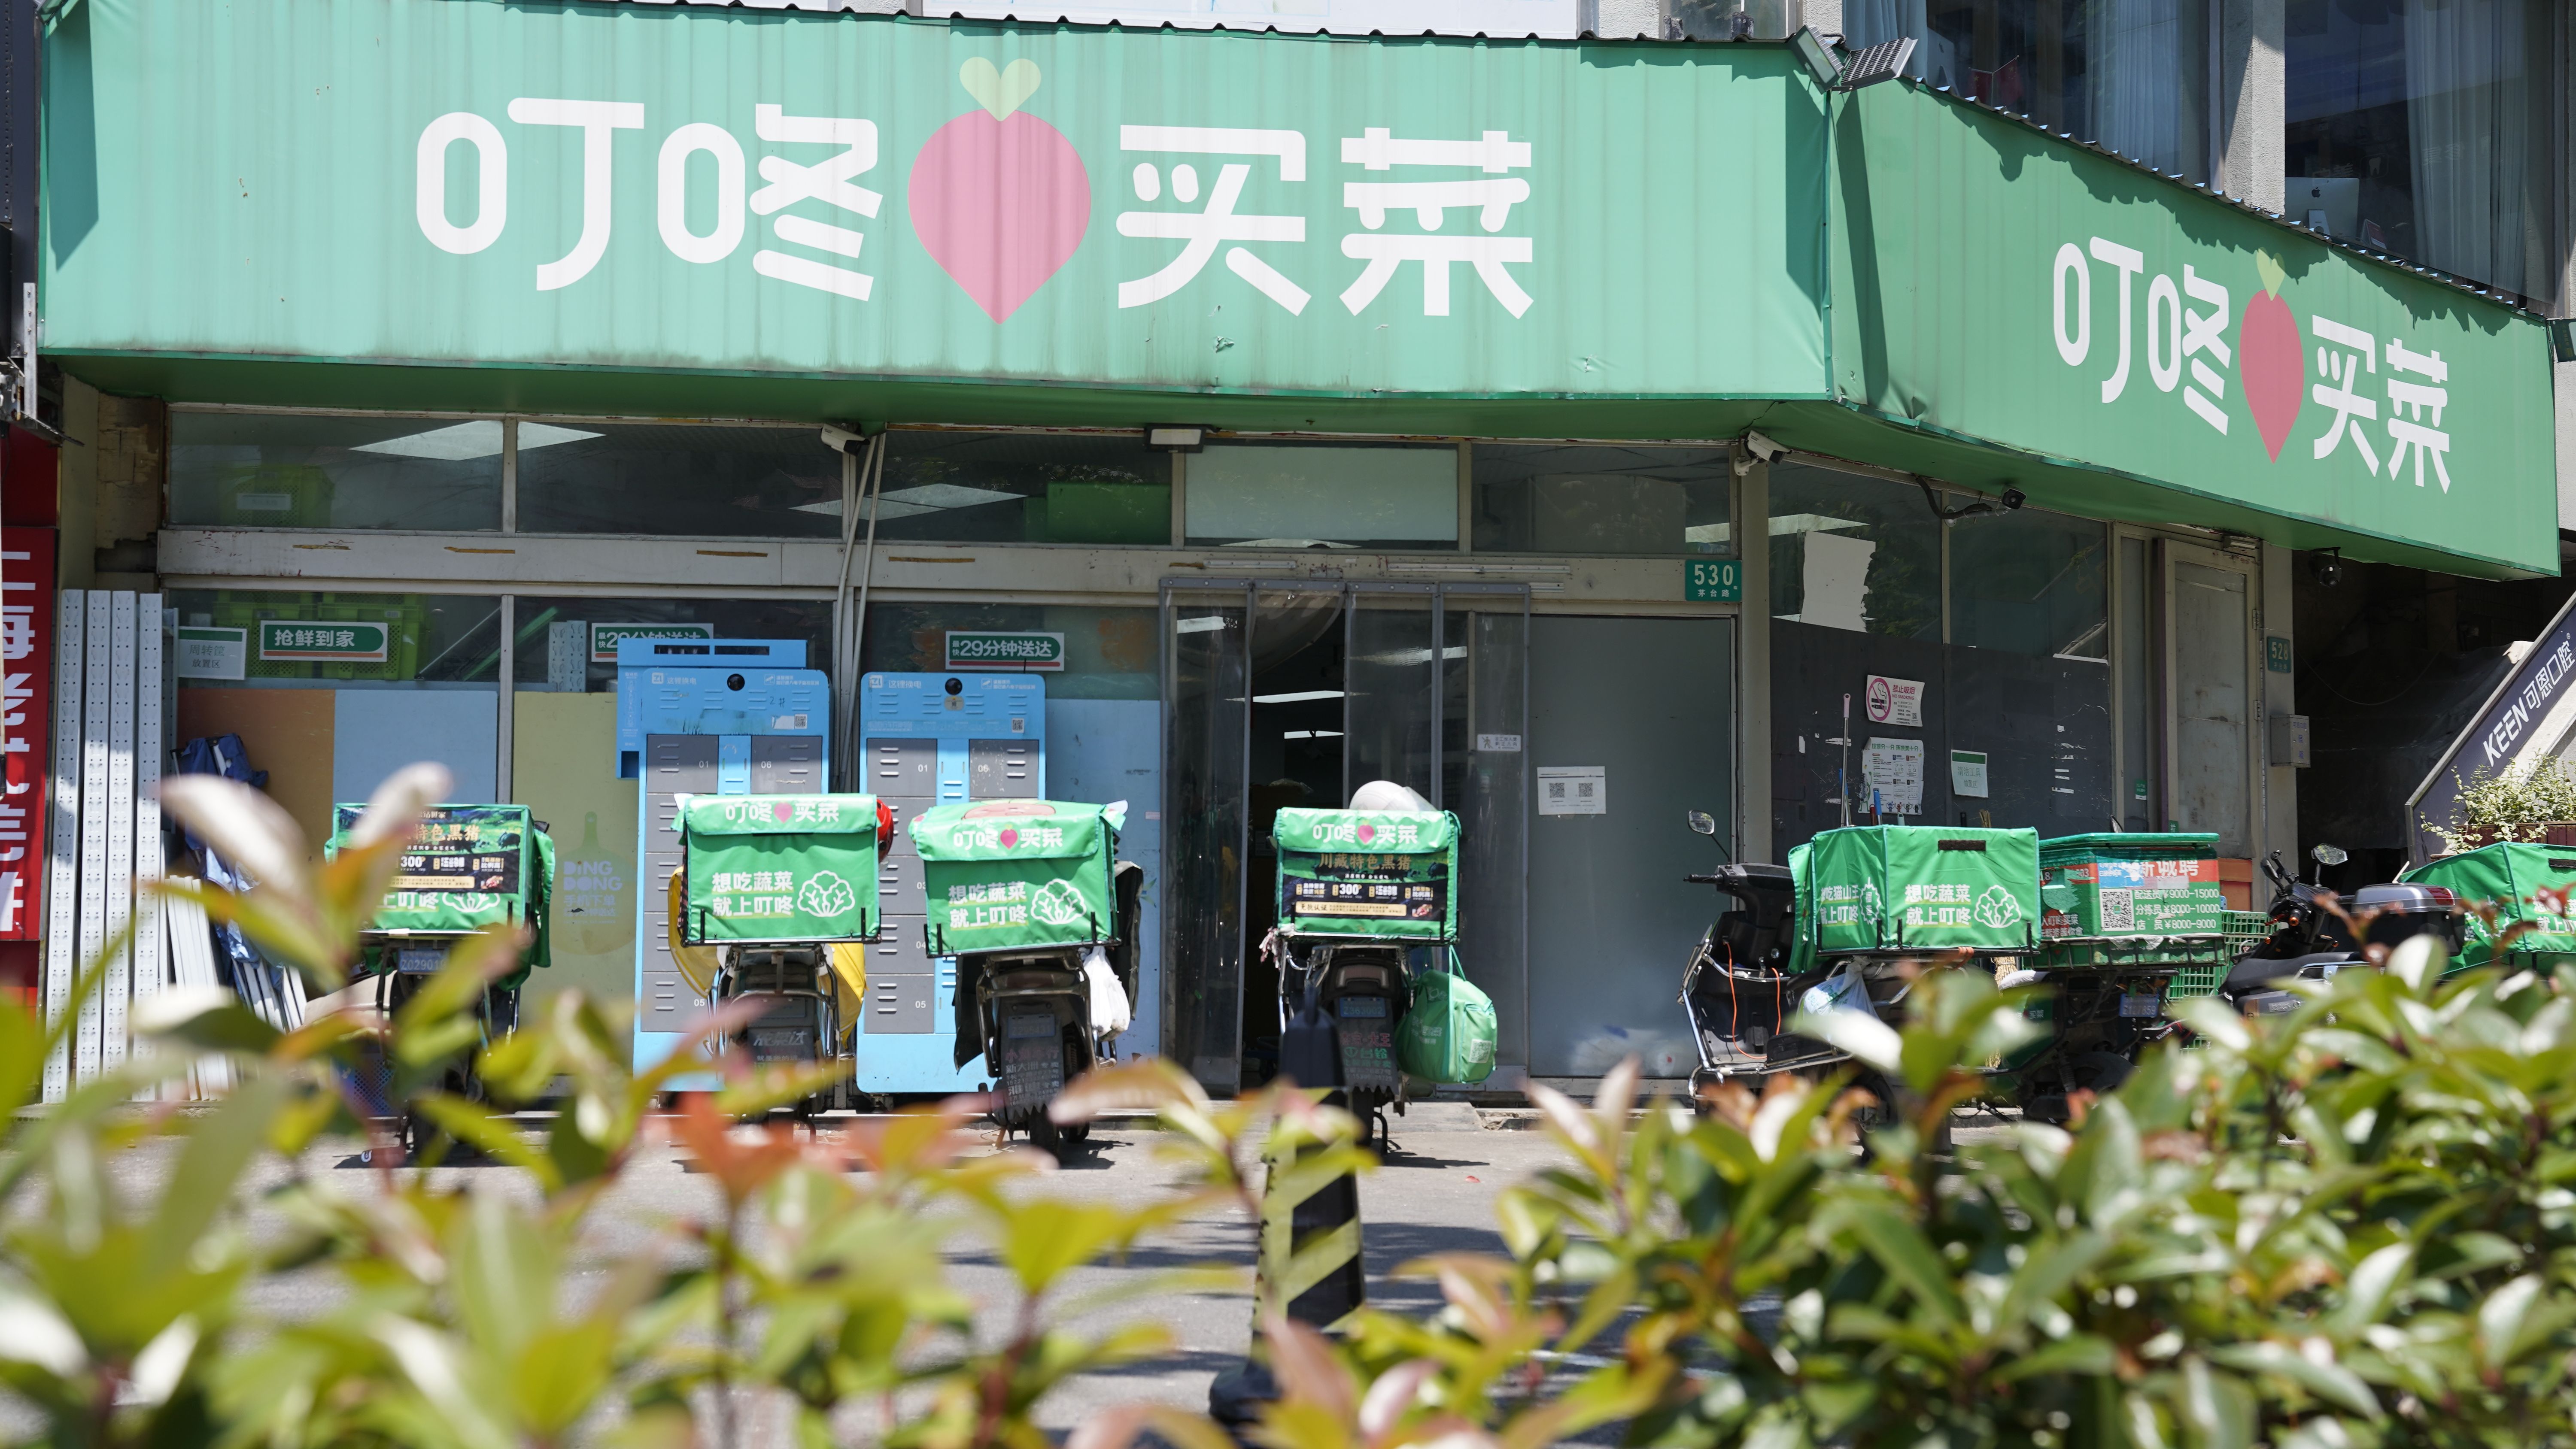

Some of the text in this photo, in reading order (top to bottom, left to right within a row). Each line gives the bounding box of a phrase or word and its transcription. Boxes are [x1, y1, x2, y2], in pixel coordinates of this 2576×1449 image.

[1694, 564, 1733, 586] 530
[1698, 589, 1729, 597] 茅台路
[275, 629, 355, 647] 抢鲜到家
[189, 644, 225, 657] 周转筐
[2271, 641, 2288, 661] 528
[192, 659, 220, 668] 放置区
[2523, 640, 2576, 709] 可恩口腔
[1893, 685, 1916, 694] 禁止吸烟
[2483, 697, 2530, 768] KEEN
[1958, 766, 1982, 777] 清洁工具
[726, 803, 839, 824] 叮咚买菜
[953, 828, 1063, 851] 叮咚买菜
[1312, 823, 1419, 845] 叮咚买菜
[1318, 853, 1411, 870] 川藏特色黑猪
[712, 871, 793, 892] 想吃蔬菜
[564, 894, 615, 907] 手机下单
[948, 881, 1027, 905] 想吃蔬菜
[1905, 883, 1971, 903] 想吃蔬菜
[712, 896, 794, 917] 就上叮咚
[1906, 906, 1971, 926] 就上叮咚
[950, 906, 1028, 929] 就上叮咚
[694, 999, 705, 1007] 05
